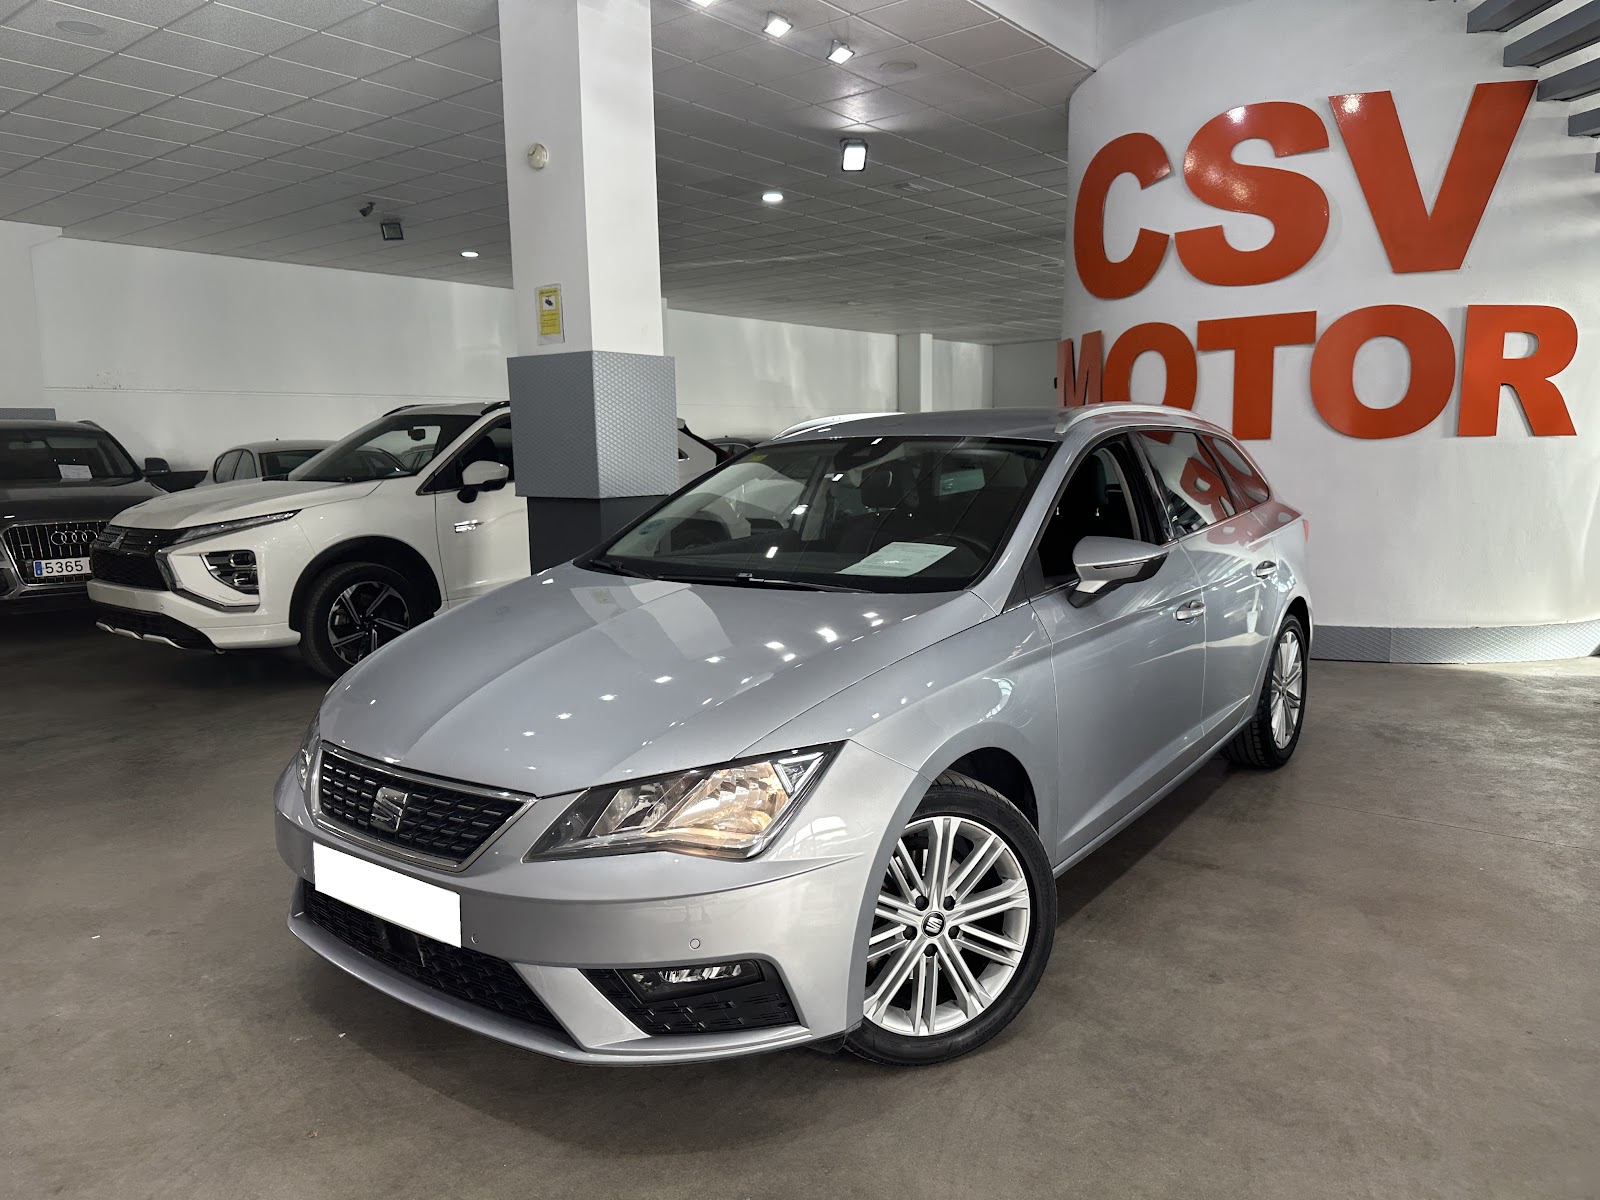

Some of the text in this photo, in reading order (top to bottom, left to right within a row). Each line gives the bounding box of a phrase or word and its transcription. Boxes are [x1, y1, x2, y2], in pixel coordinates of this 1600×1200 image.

[1074, 80, 1538, 299] CSV
[1057, 304, 1578, 440] MOTOR
[45, 560, 83, 574] 5365
